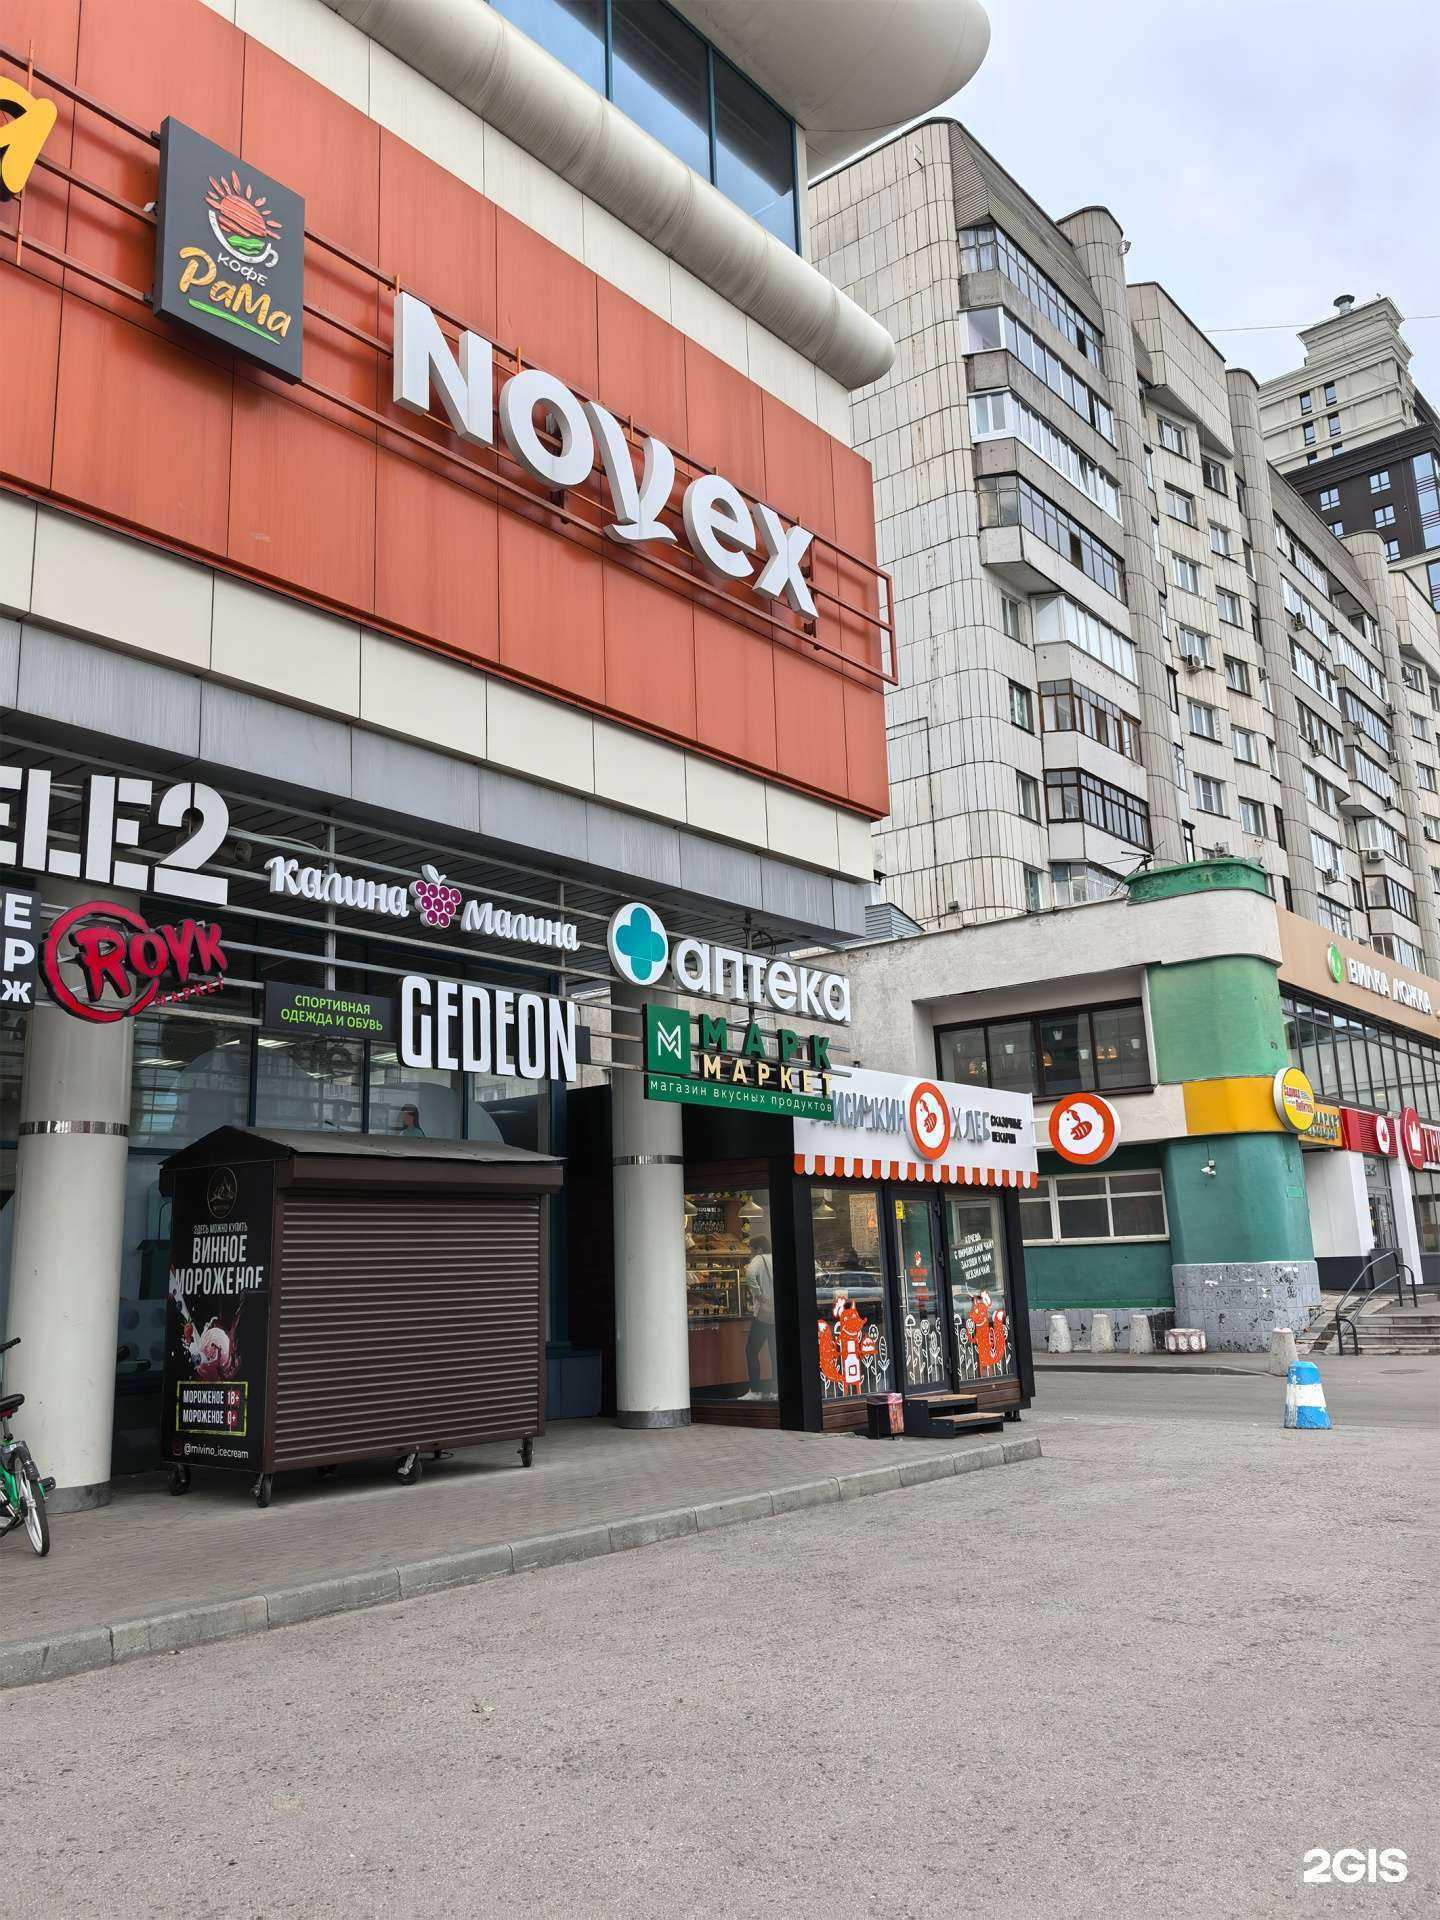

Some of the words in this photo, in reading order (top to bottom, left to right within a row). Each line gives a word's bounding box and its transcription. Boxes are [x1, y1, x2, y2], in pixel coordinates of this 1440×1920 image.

[217, 252, 269, 287] КОФЕ
[264, 855, 410, 918] Калина
[460, 899, 581, 952] Малина
[671, 938, 851, 1023] аптека
[1346, 957, 1391, 998] ВИЛКА
[281, 1008, 333, 1027] ОДЕЖДА
[335, 1015, 344, 1027] И
[347, 1016, 383, 1031] ОБУВЬ
[295, 994, 371, 1016] СПОРТИВНАЯ
[400, 975, 577, 1082] GEDEON
[699, 1013, 832, 1070] МАРК
[701, 1054, 833, 1098] МАРКЕТ
[650, 1079, 707, 1097] магазин
[713, 1088, 765, 1104] вкусных
[771, 1095, 833, 1114] продуктов
[818, 1088, 907, 1135] ИСИЧКИН
[192, 1234, 248, 1264] ВИННОЕ
[175, 1265, 264, 1295] МОРОЖЕНОЕ
[183, 1390, 224, 1404] МОРОЖЕНОЕ
[227, 1391, 240, 1405] 18+
[182, 1409, 224, 1424] МОРОЖЕНОЕ
[227, 1411, 237, 1425] 0+
